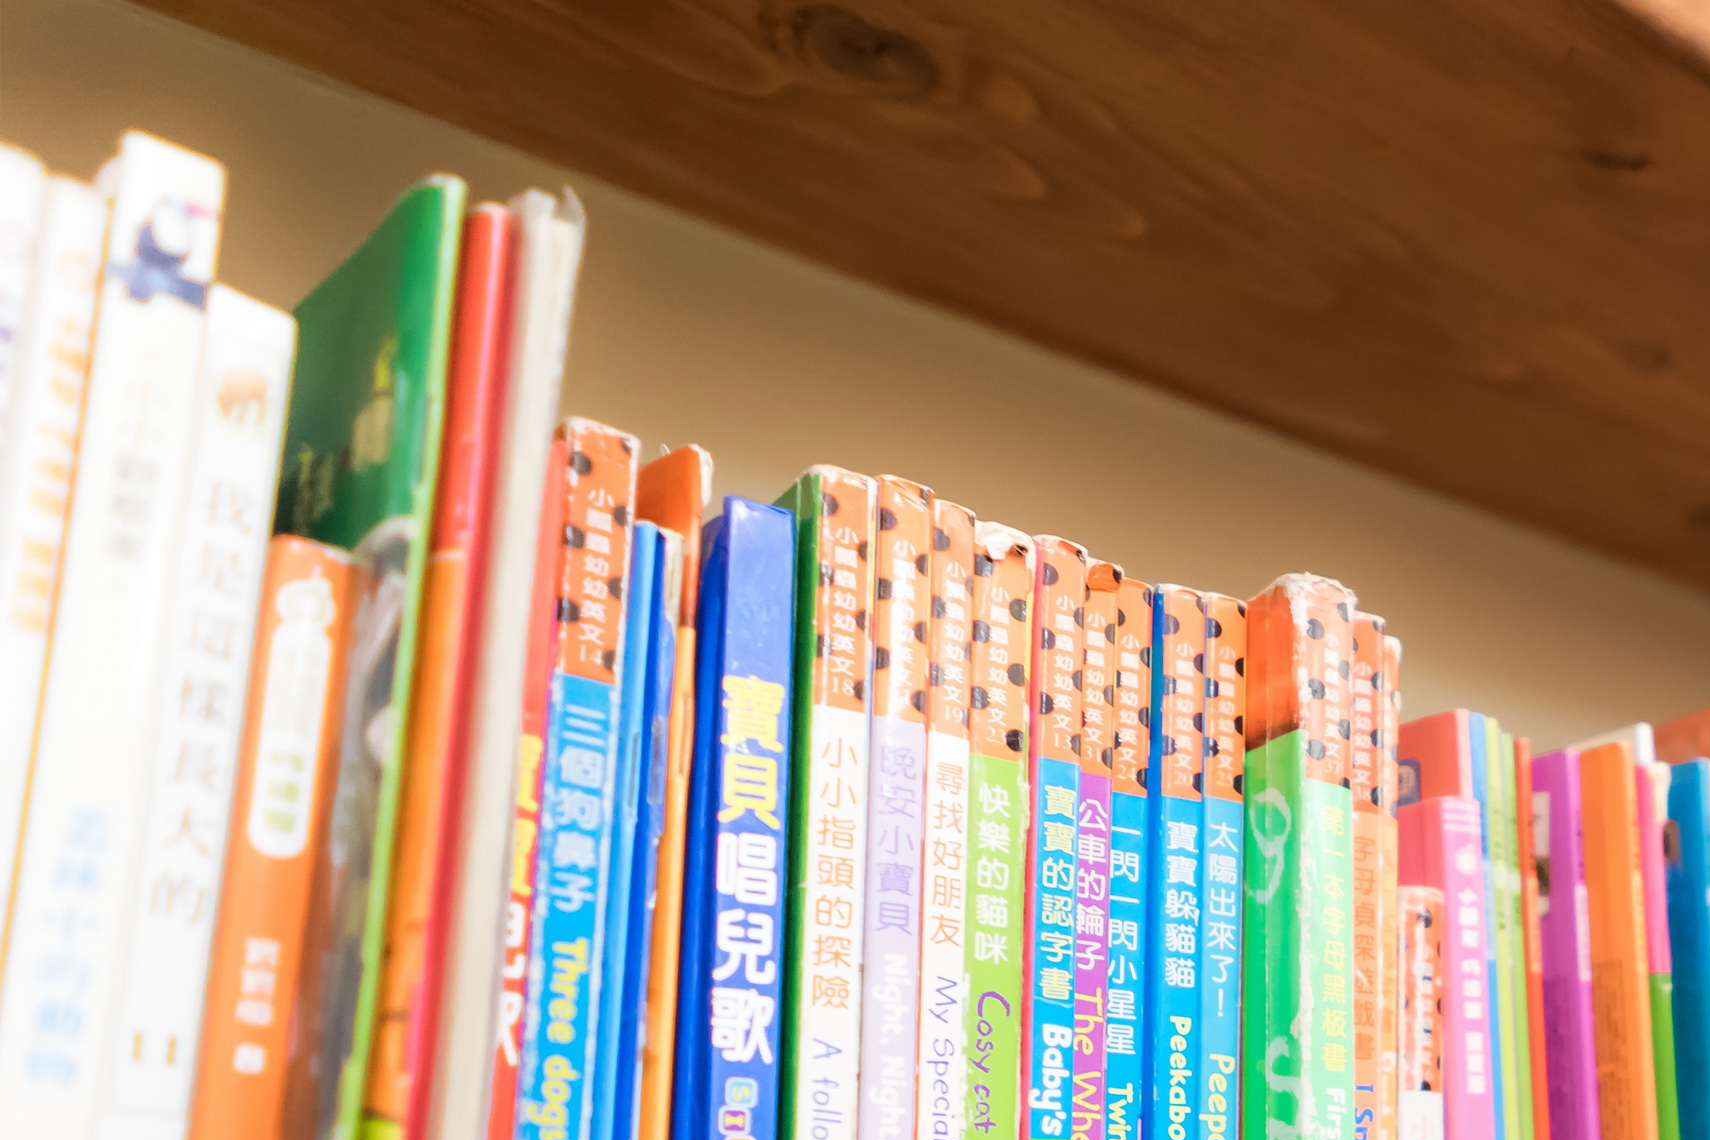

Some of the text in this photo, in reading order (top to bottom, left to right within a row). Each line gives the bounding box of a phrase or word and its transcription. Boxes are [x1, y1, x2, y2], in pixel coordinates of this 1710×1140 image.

[710, 674, 785, 1064] 寶貝唱兒歌
[810, 737, 861, 1012] 小小指頭的探險
[875, 744, 918, 936] 晚安小寶貝
[929, 761, 966, 949] 尋找好朋友
[1038, 784, 1077, 1002] 寶寶的認字書
[1075, 798, 1109, 973] 公車的輪子
[1164, 821, 1200, 990] 寶寶躲貓貓
[1207, 821, 1239, 1017] 太陽出來了!
[547, 937, 587, 1046] Three
[930, 975, 958, 1024] My
[968, 782, 1012, 1136] 快樂的貓咪 Cosy cat
[1072, 984, 1105, 1058] The
[1104, 826, 1142, 1058] 一閃一閃小星星
[1321, 805, 1349, 1074] 第一本字母黑板書
[811, 1037, 844, 1062] A
[1030, 1022, 1074, 1137] Baby's
